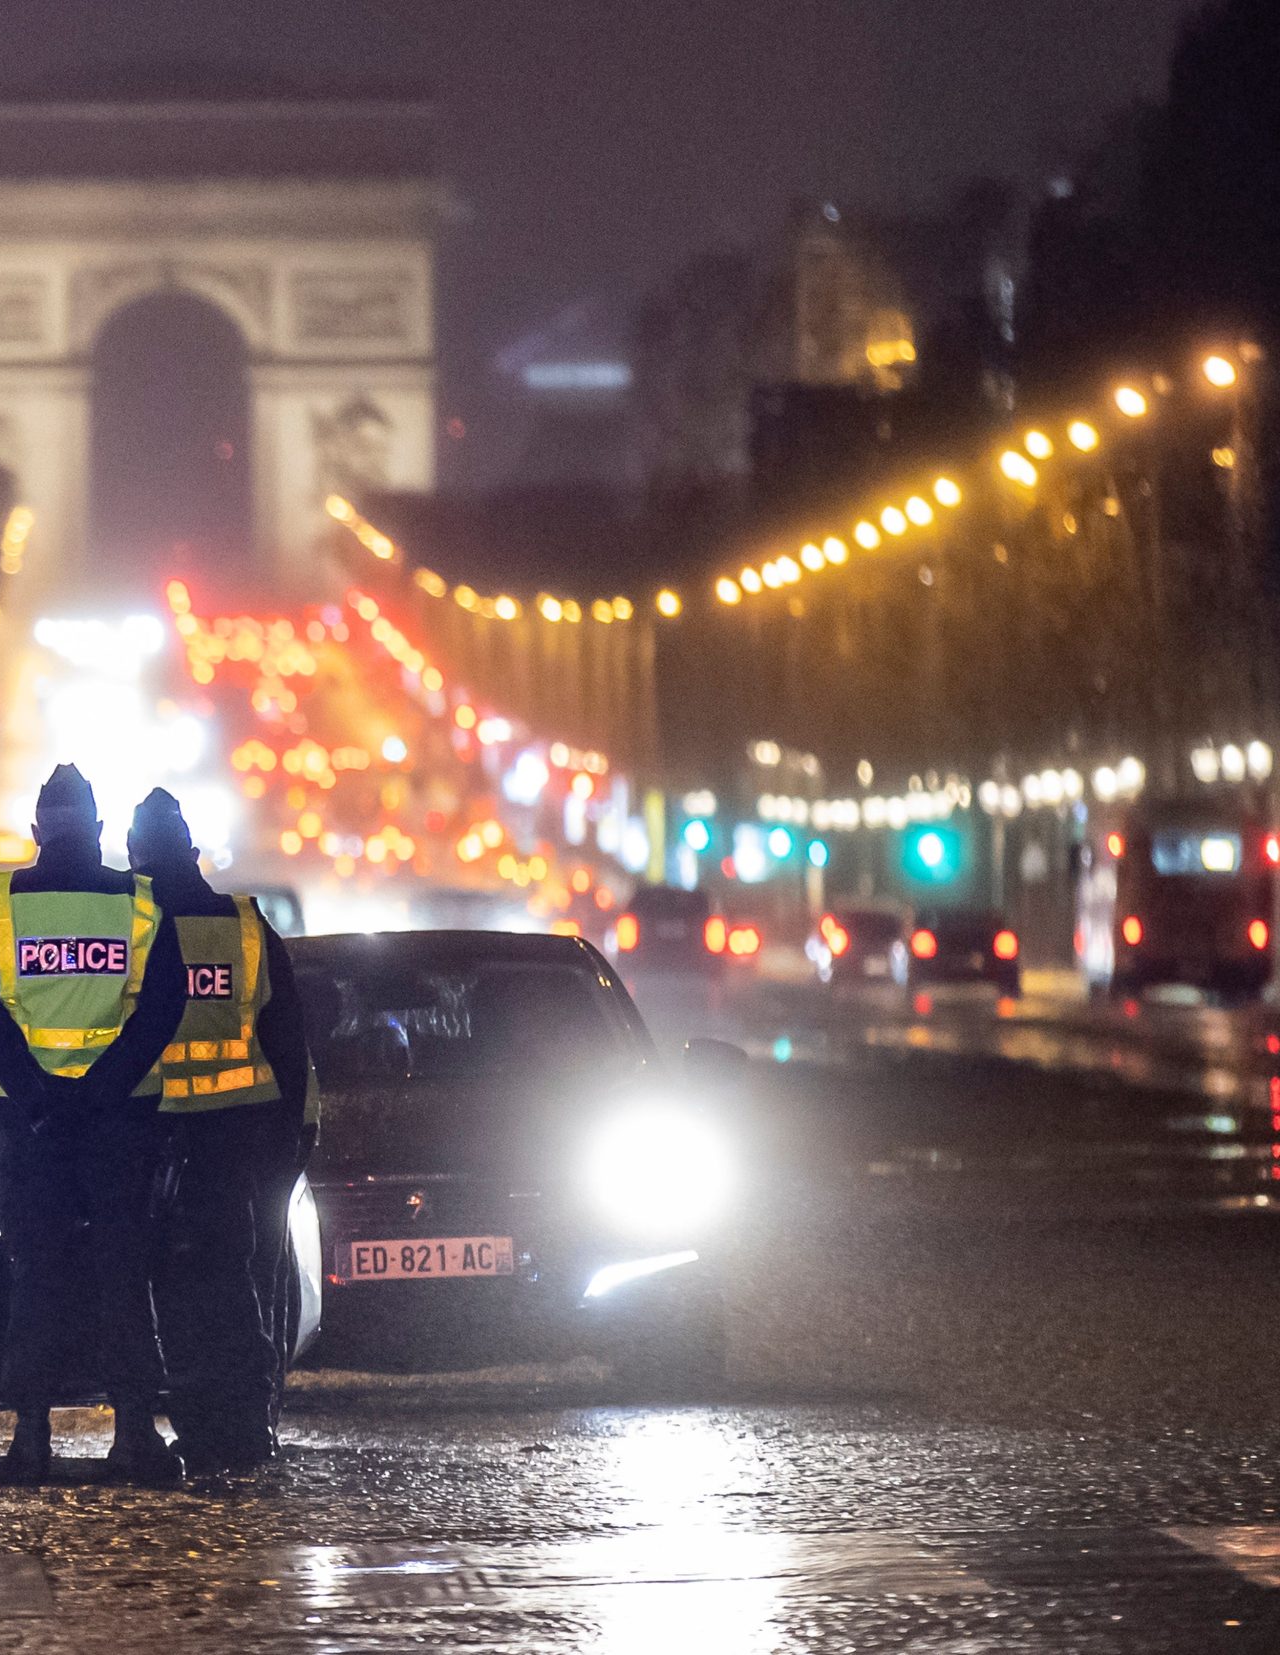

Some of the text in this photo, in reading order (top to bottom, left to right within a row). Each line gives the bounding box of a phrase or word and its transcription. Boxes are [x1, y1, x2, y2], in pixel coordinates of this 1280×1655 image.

[21, 943, 125, 971] POLICE
[187, 967, 231, 997] ICE
[356, 1242, 493, 1275] ED-821-AC
